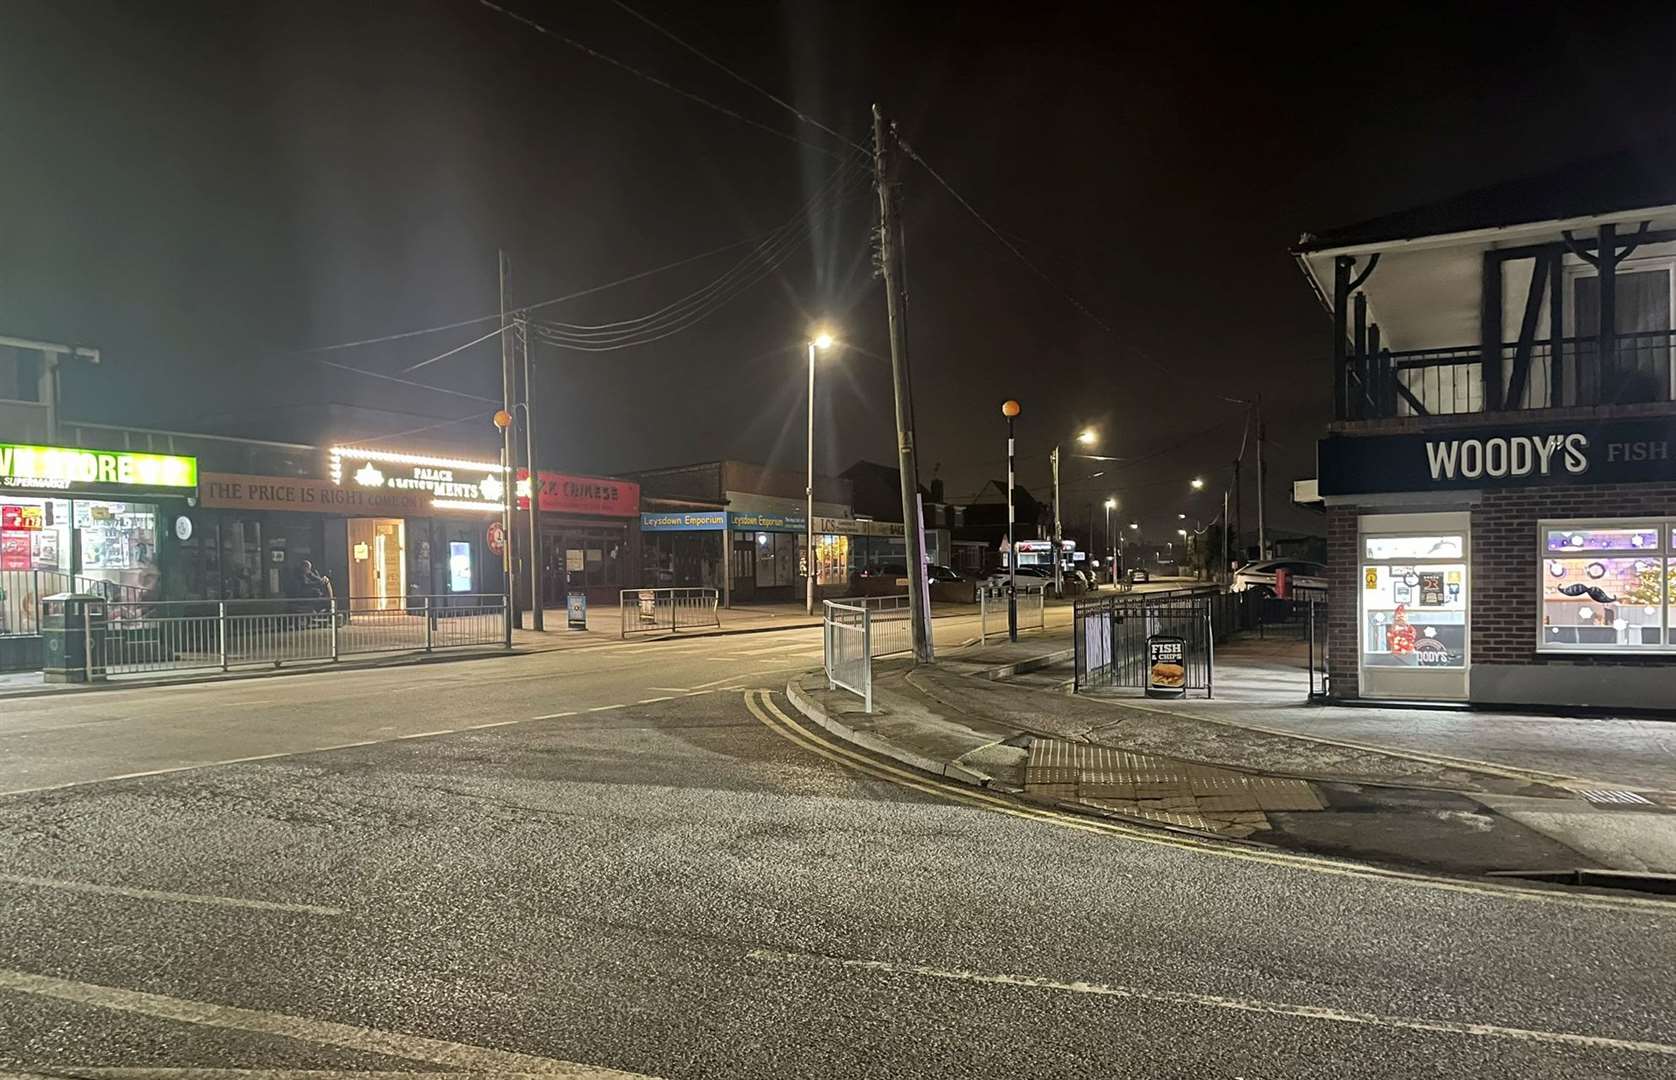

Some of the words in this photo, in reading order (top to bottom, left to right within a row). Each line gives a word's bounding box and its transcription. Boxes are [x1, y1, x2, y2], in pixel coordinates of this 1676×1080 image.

[1426, 433, 1588, 479] WOODY'S
[1607, 441, 1668, 462] FISH
[413, 467, 453, 481] PALACE
[208, 482, 242, 499] THE
[249, 485, 295, 502] PRICE
[301, 487, 315, 503] IS
[320, 488, 363, 505] RIGHT
[644, 516, 681, 527] Leysdown
[684, 515, 724, 526] Emporium
[1151, 643, 1181, 654] FISH
